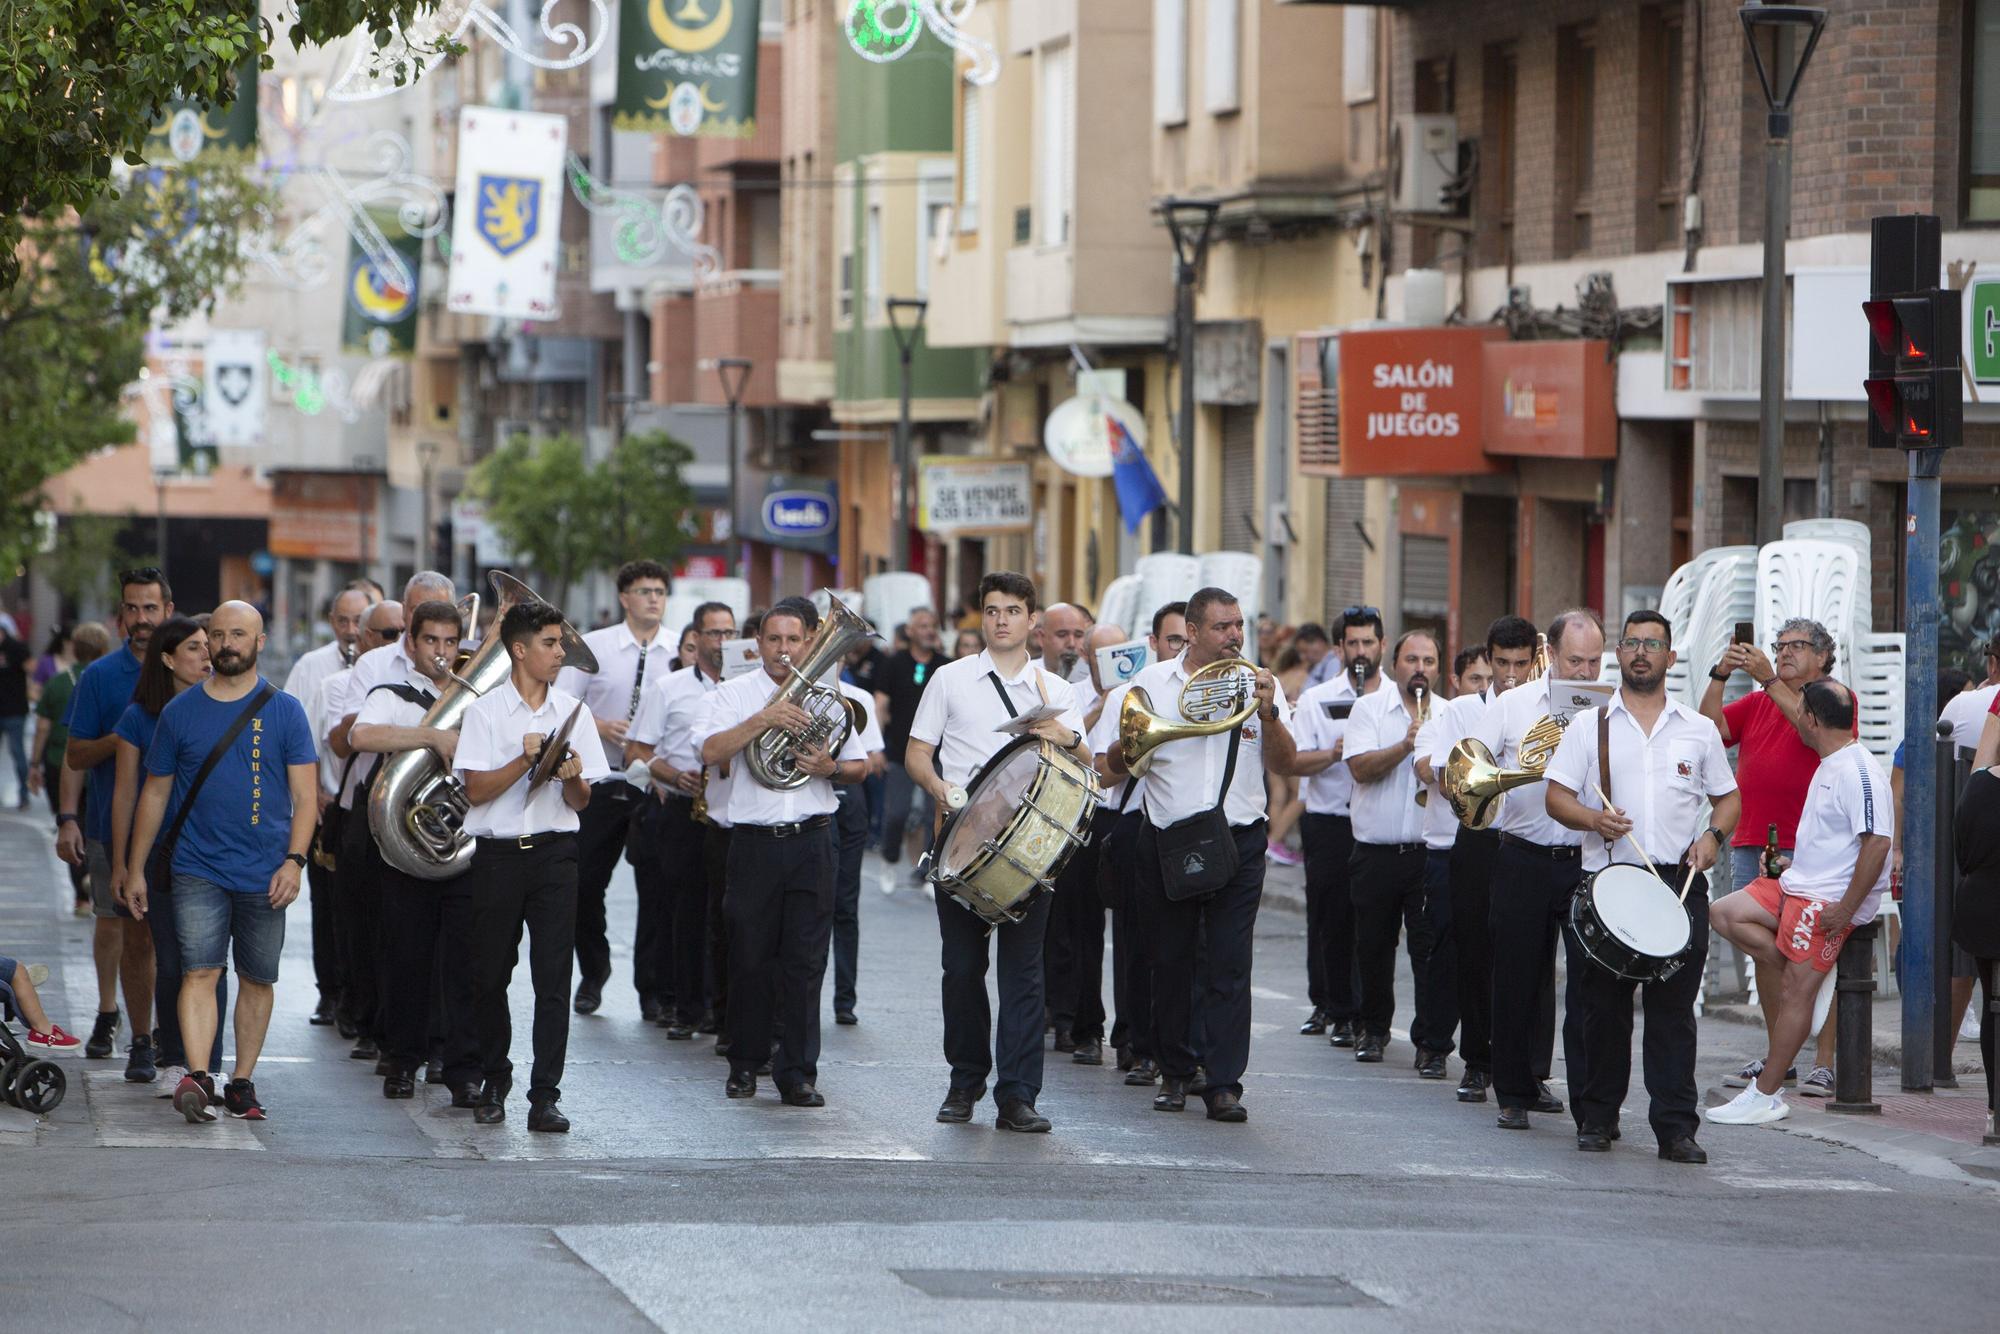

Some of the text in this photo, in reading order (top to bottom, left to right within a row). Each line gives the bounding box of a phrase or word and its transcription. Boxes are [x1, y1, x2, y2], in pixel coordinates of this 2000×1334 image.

[1372, 358, 1454, 389] SALÓN
[1401, 392, 1428, 412] DE
[1366, 411, 1461, 441] JUEGOS
[936, 484, 1018, 503] SE VENDE
[251, 717, 265, 825] Leoneses
